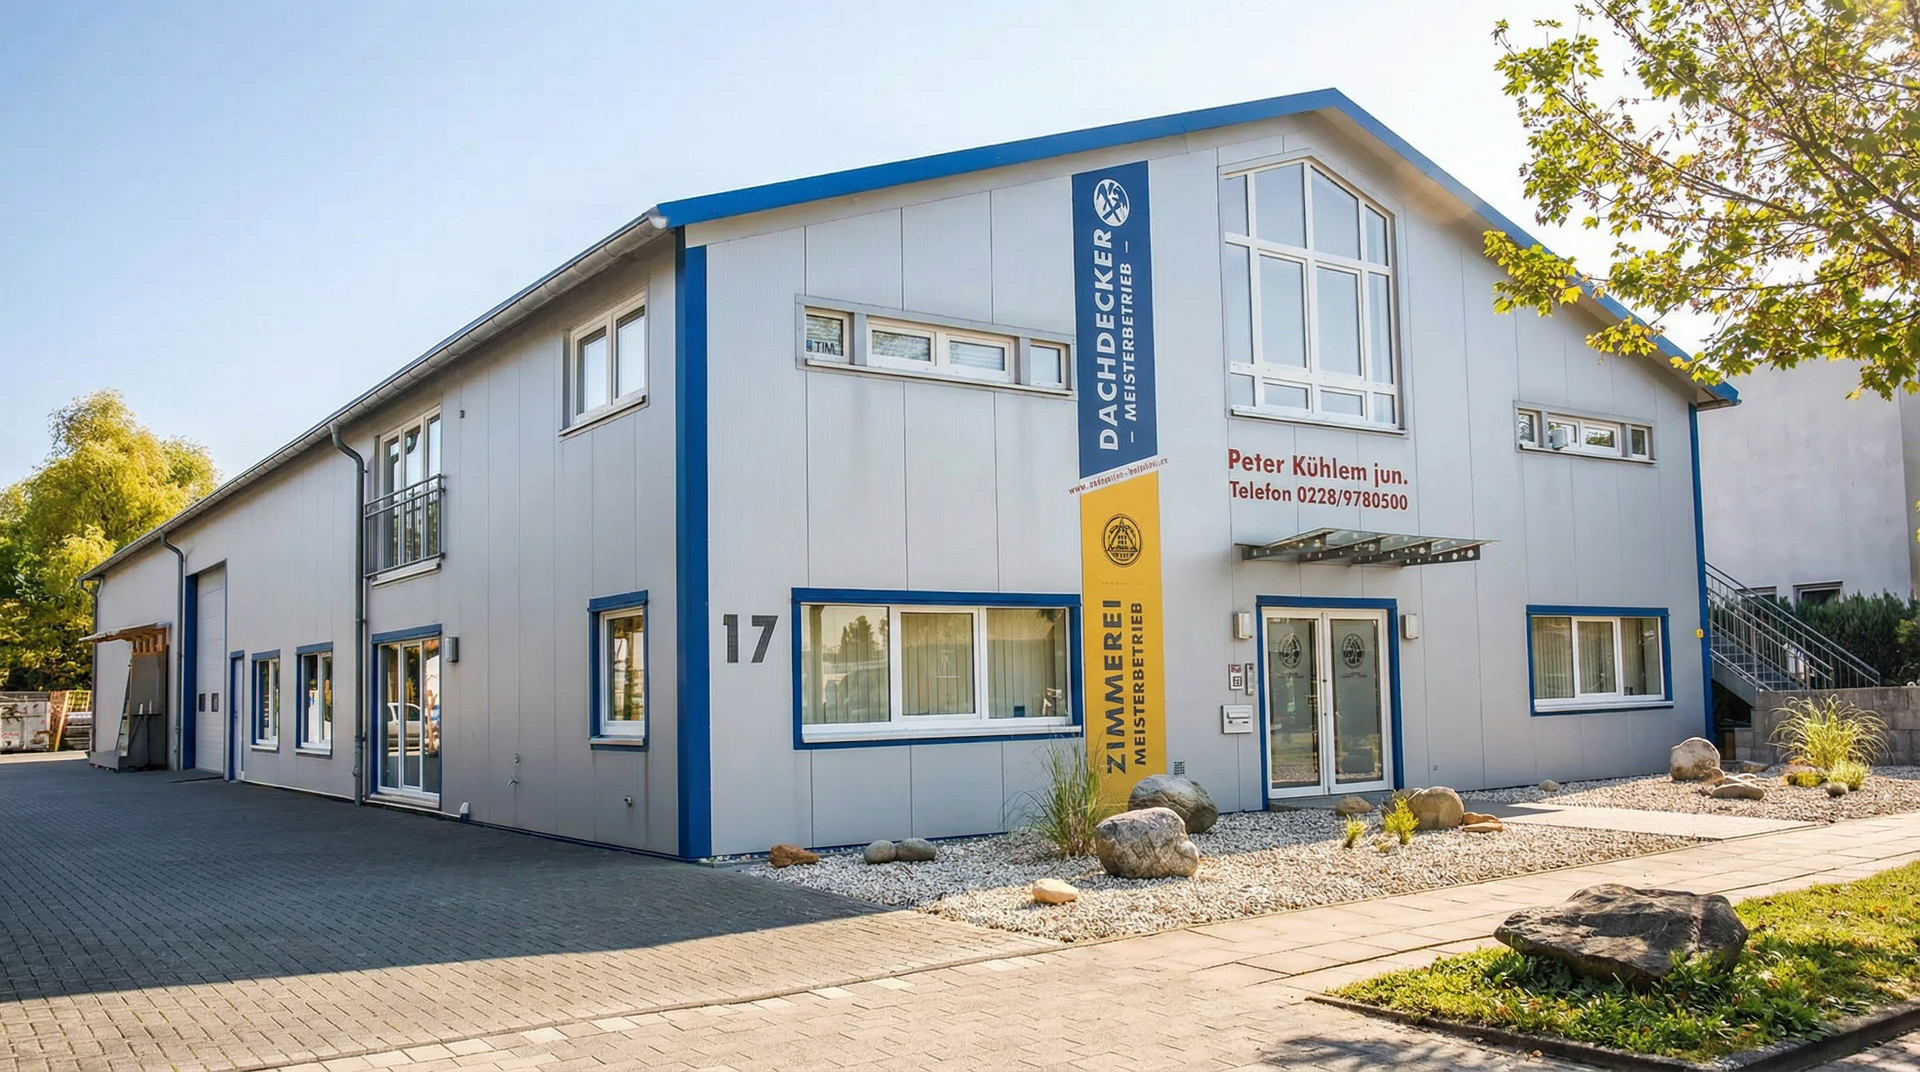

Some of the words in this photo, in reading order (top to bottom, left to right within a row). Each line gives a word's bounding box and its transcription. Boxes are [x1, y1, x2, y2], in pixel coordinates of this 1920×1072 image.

[814, 341, 835, 355] TIM
[1093, 228, 1119, 451] DACHDECKER
[1120, 263, 1137, 422] MEISTERBETRIEB
[1228, 448, 1285, 474] Peter
[1292, 455, 1367, 481] Kühlem
[1374, 463, 1408, 488] jun.
[1229, 480, 1292, 502] Telefon
[1297, 486, 1408, 511] 0228/9780500
[723, 614, 779, 664] 17
[1102, 600, 1126, 775] ZIMMEREI
[1130, 602, 1147, 766] MEISTERBETRIEB
